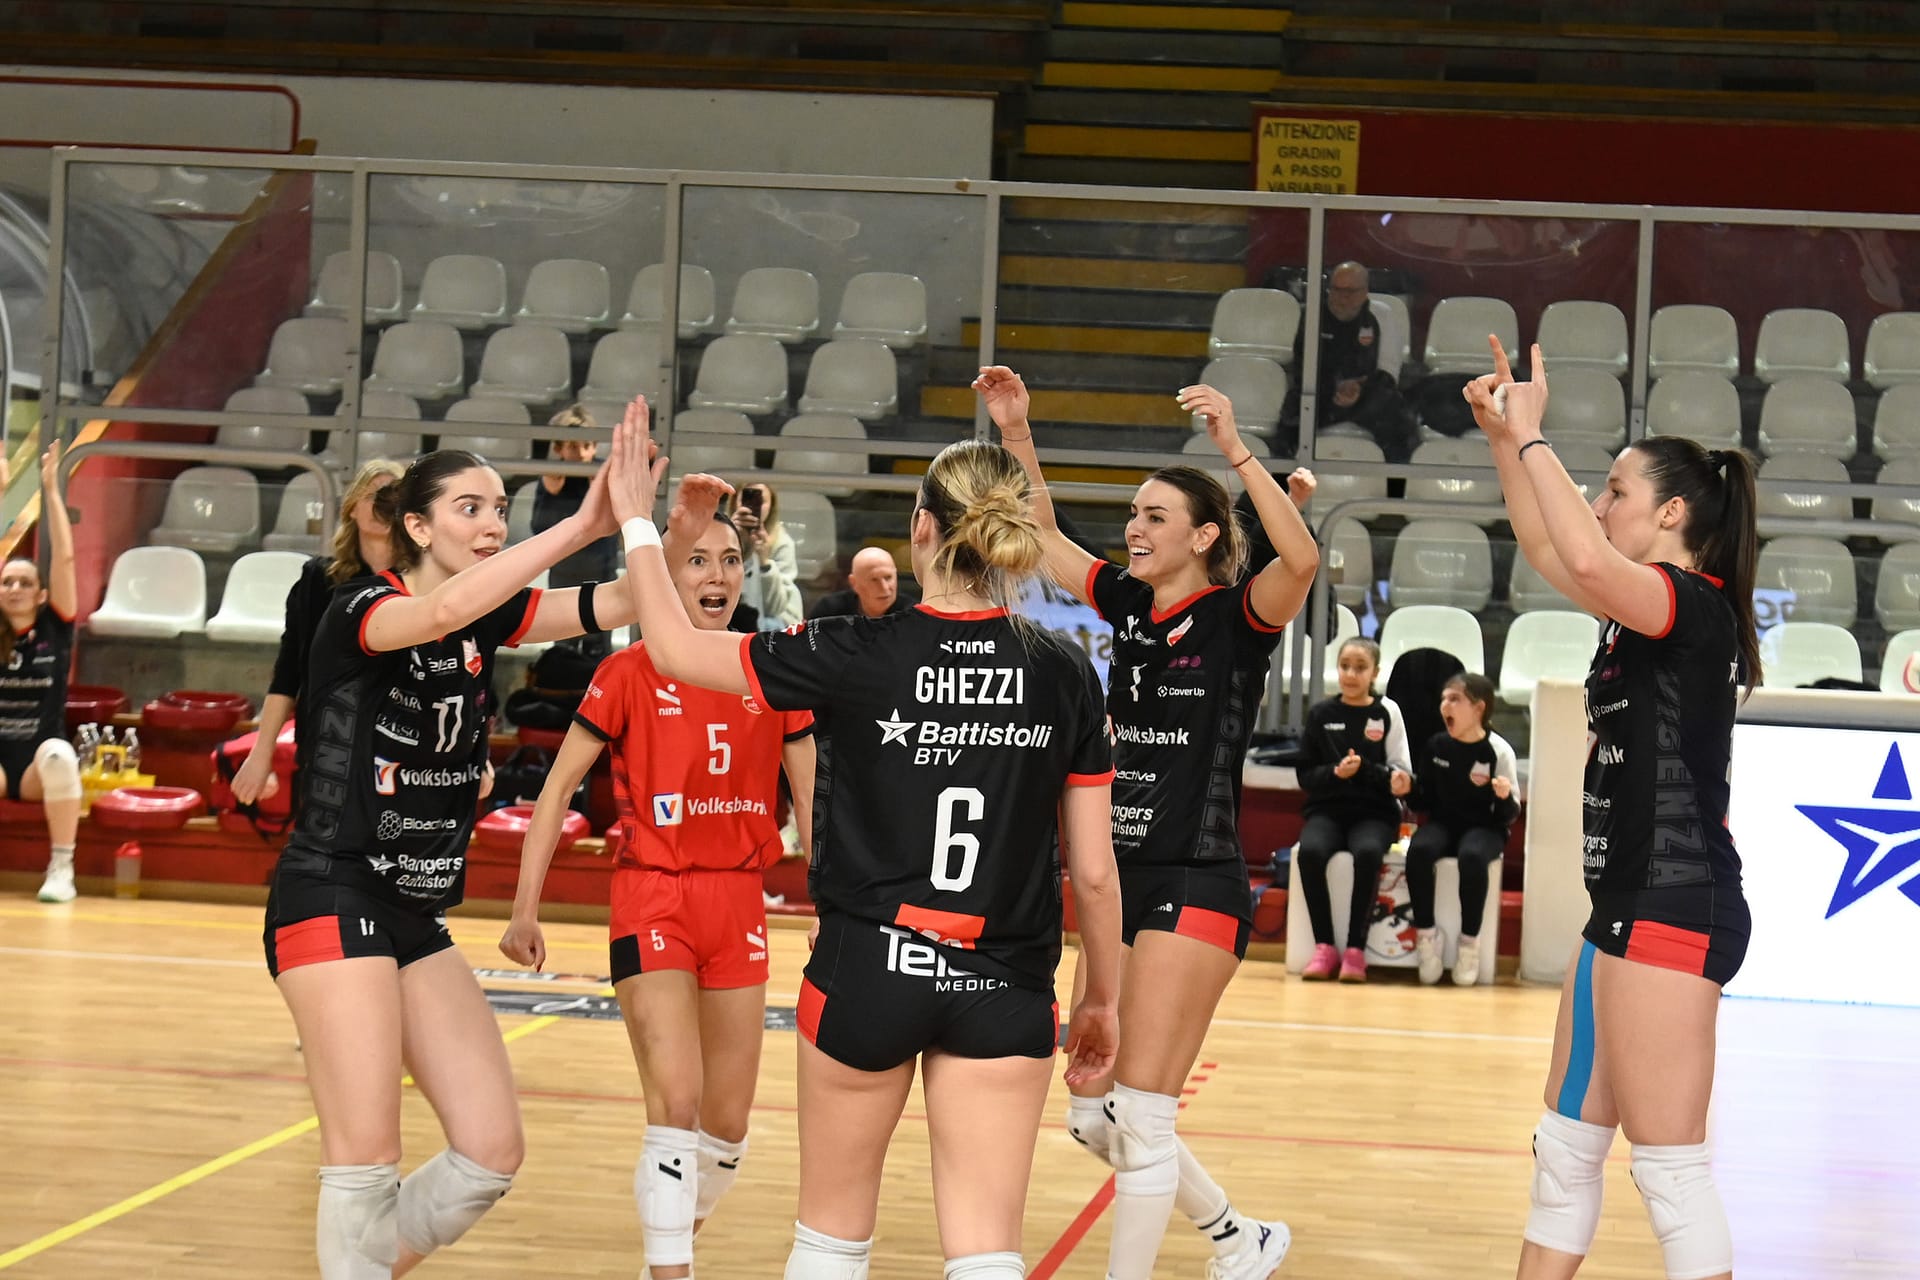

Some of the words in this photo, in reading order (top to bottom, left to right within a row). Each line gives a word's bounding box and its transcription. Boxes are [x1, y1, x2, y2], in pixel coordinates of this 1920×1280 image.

[1263, 121, 1357, 141] ATTENZIONE
[1278, 145, 1341, 160] GRADINI
[1272, 163, 1283, 177] A
[1291, 164, 1342, 178] PASSO
[955, 640, 996, 654] nine
[915, 666, 1024, 705] GHEZZI
[658, 707, 683, 716] nine
[918, 721, 1053, 748] Battistolli
[706, 723, 731, 775] 5
[914, 748, 962, 766] BTV
[1116, 769, 1156, 782] activa
[687, 796, 767, 816] Volksban
[1111, 804, 1154, 821] ngers
[1112, 822, 1148, 837] tistolli
[930, 786, 985, 893] 6
[398, 854, 464, 875] Rangers
[651, 929, 666, 951] 5
